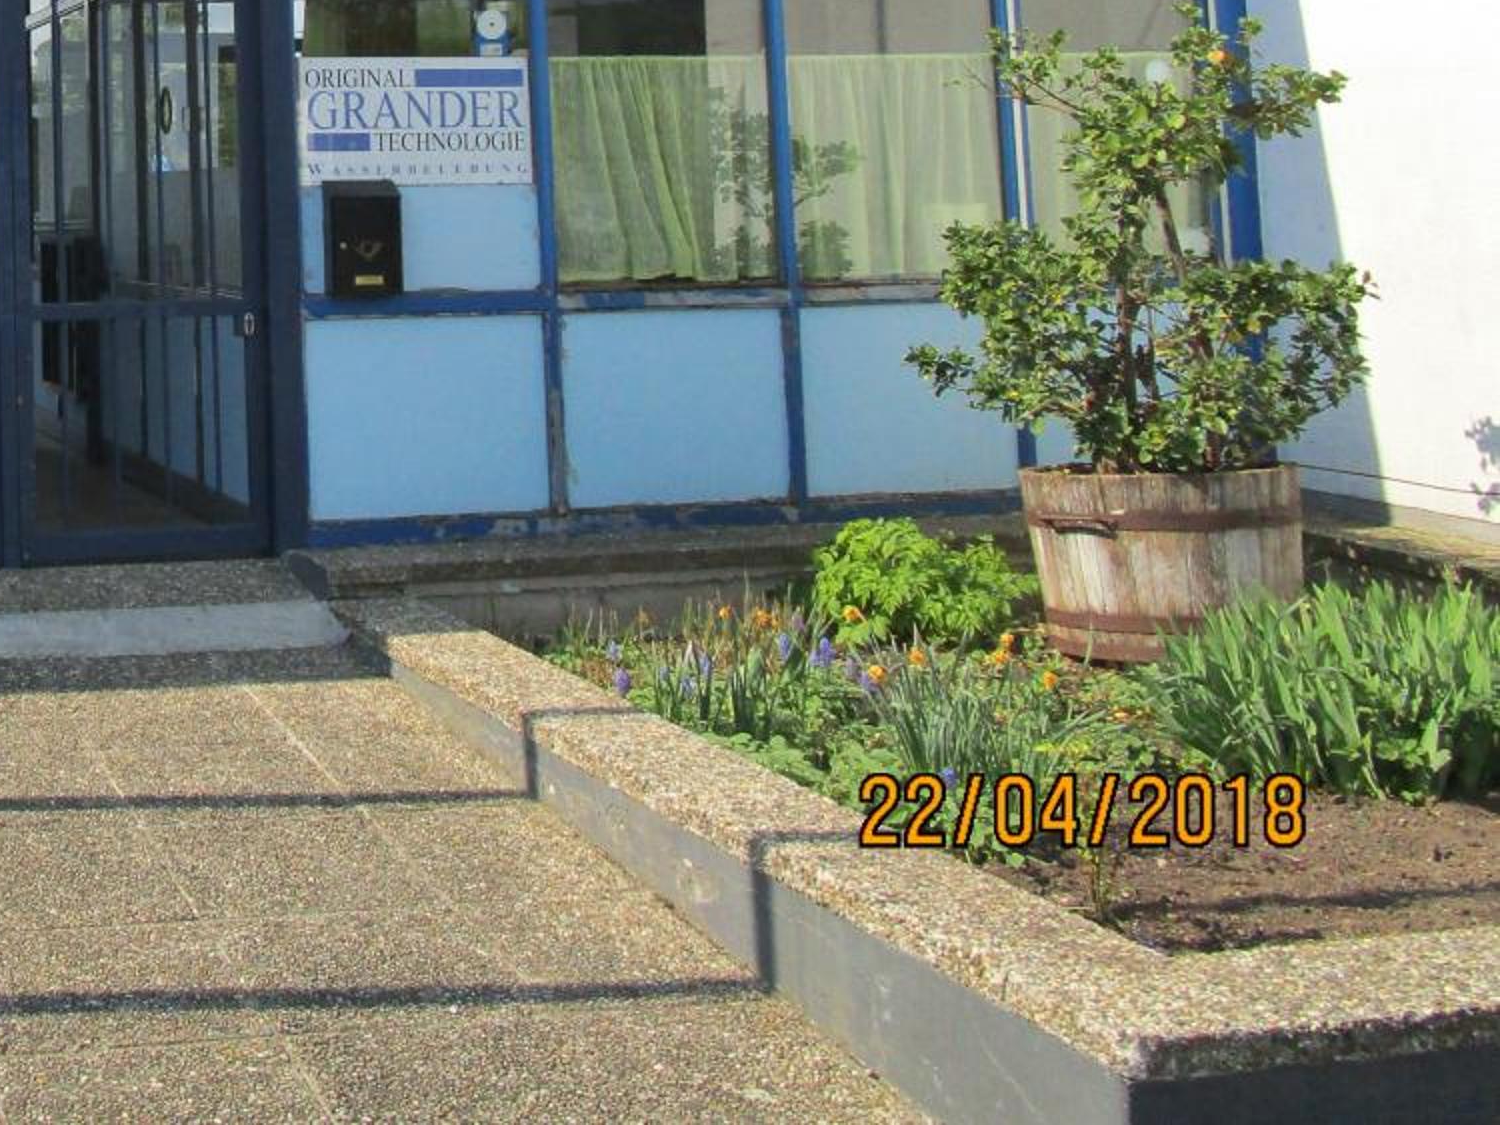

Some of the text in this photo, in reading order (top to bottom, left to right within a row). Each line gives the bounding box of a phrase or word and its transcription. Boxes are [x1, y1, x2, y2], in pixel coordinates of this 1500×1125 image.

[304, 68, 411, 89] ORIGINAL
[306, 90, 526, 130] GRANDER
[371, 130, 526, 152] TECHNOLOGIE
